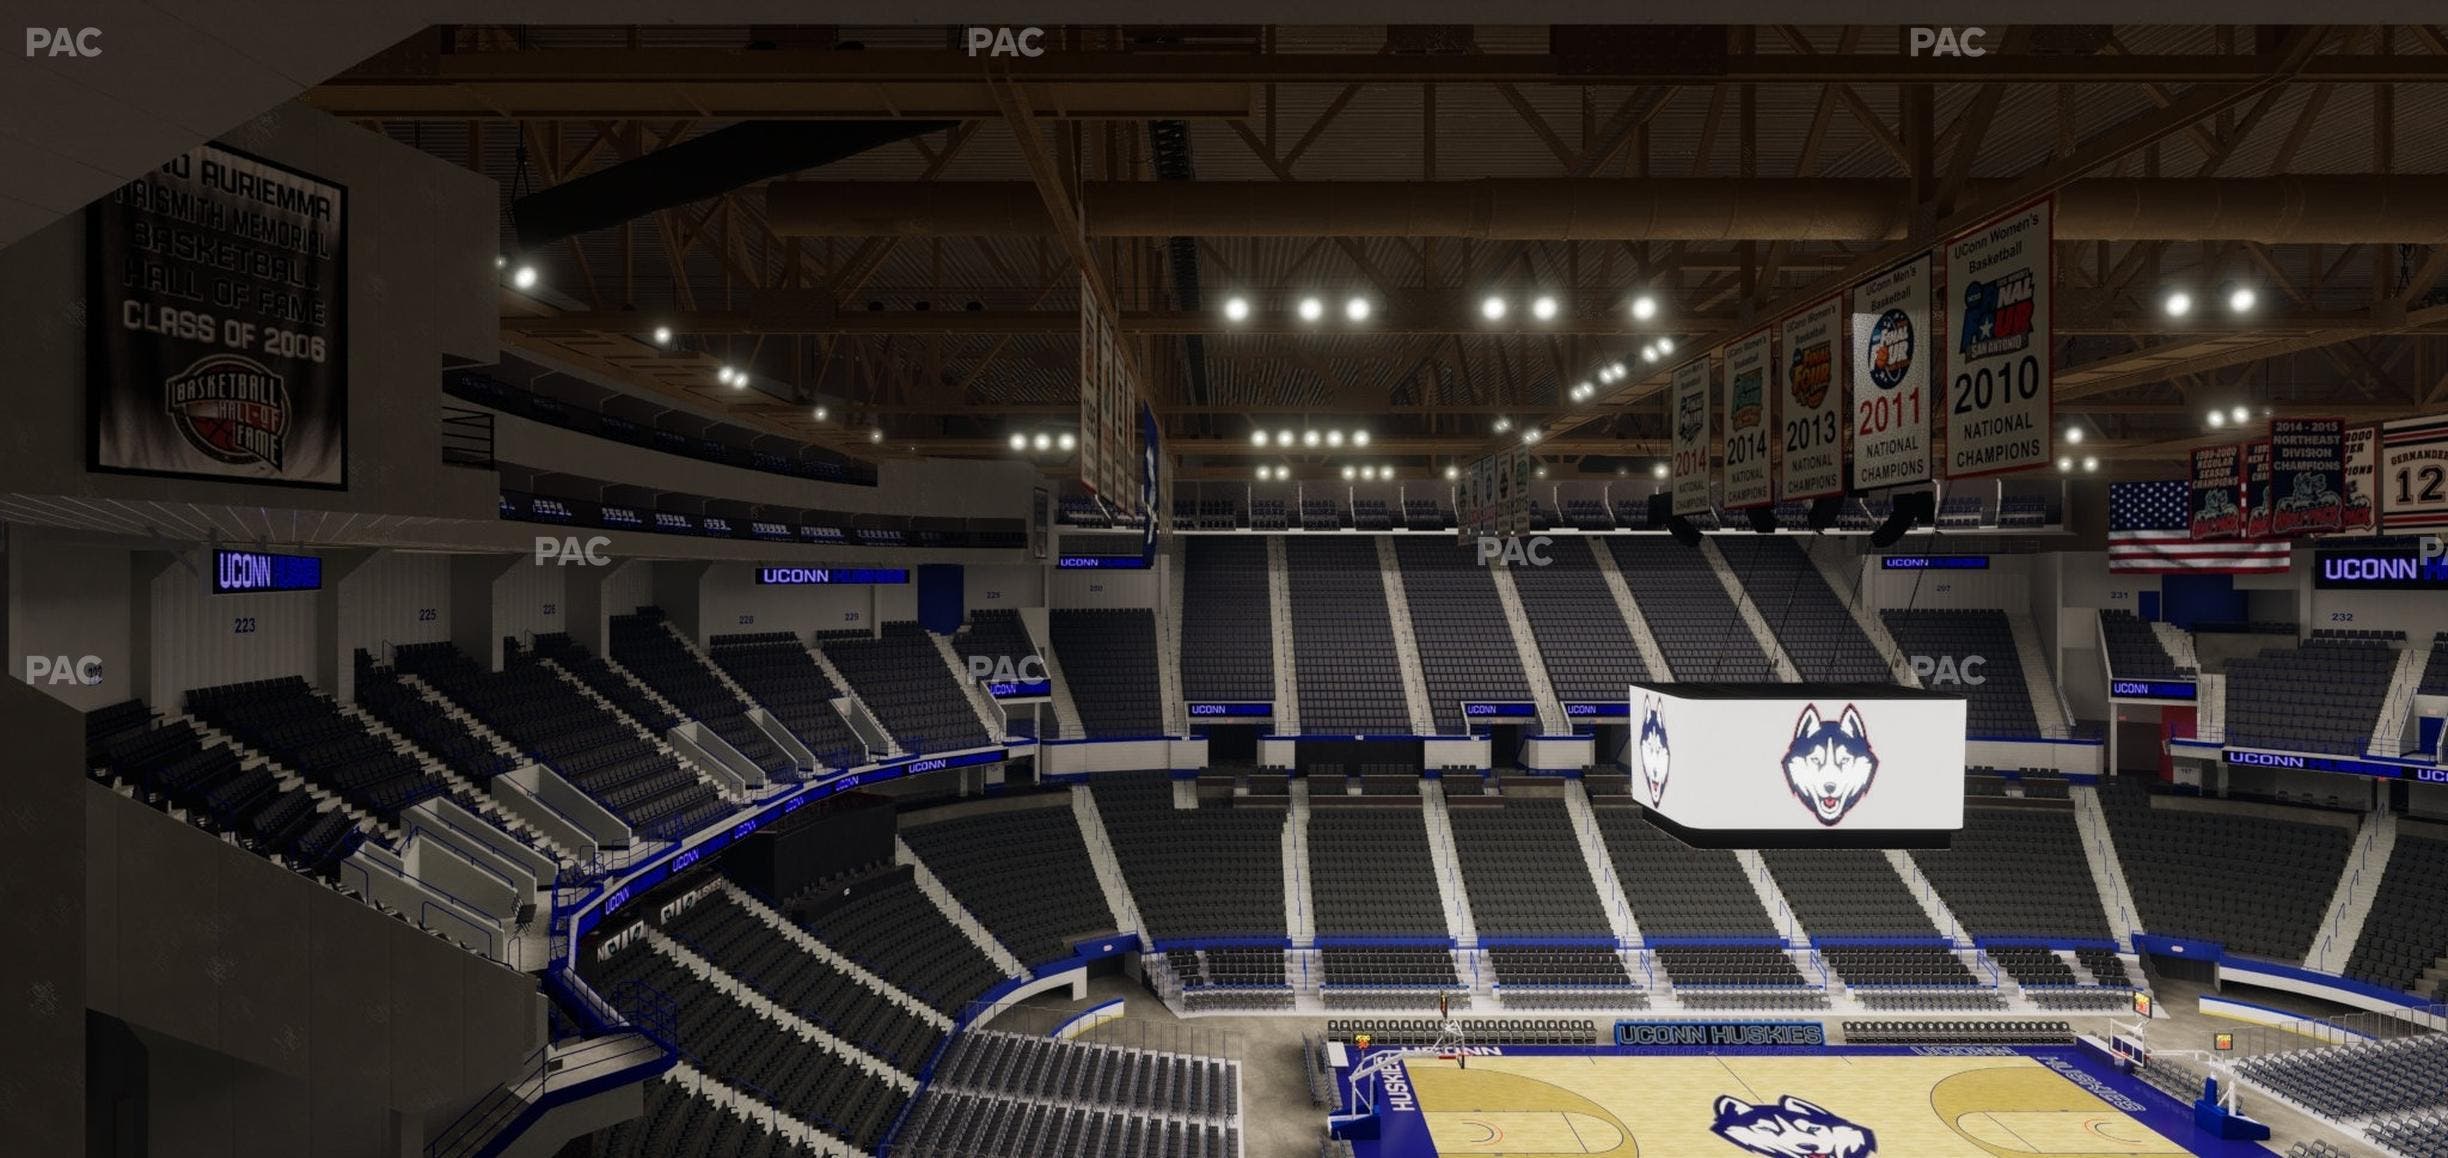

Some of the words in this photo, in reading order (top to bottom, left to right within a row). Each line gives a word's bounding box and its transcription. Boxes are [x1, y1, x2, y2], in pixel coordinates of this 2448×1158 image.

[201, 161, 331, 222] AURIEMMA
[122, 300, 217, 345] CLASS
[222, 318, 259, 350] OF
[263, 326, 327, 363] 2006
[176, 373, 279, 408] BASKETBALL
[1954, 355, 2039, 415] 2010
[1860, 387, 1920, 437] 2011
[1787, 410, 1836, 452] 2013
[1964, 412, 2033, 440] NATIONAL
[2276, 422, 2303, 432] 2014
[2312, 422, 2339, 433] 2015
[236, 422, 280, 466] FAME
[1727, 430, 1767, 465] 2014
[1866, 437, 1919, 458] NATIONAL
[2273, 435, 2341, 446] NORTHEAST
[1675, 445, 1707, 478] 2014
[1957, 439, 2040, 468] CHAMPIONS
[2282, 448, 2332, 458] DIVISION
[1792, 453, 1833, 473] NATIONAL
[1861, 459, 1924, 483] CHAMPIONS
[2273, 460, 2341, 471] CHAMPIONS
[2396, 464, 2447, 506] 12
[219, 552, 271, 589] UCONN
[1060, 558, 1098, 567] UCONN
[1886, 558, 1929, 567] UCONN
[2326, 558, 2417, 580] UCONN
[764, 568, 829, 583] UCONN
[419, 608, 437, 621] 225
[2331, 612, 2353, 622] 232
[235, 618, 256, 634] 223
[2114, 682, 2148, 695] UCONN
[1191, 704, 1227, 715] UCONN
[1467, 704, 1497, 715] UCONN
[1567, 704, 1597, 715] UCONN
[909, 758, 946, 774] UCONN
[2228, 752, 2305, 769] UCONN
[1620, 1026, 1707, 1045] UCONN
[1711, 1026, 1823, 1045] HUSKIES
